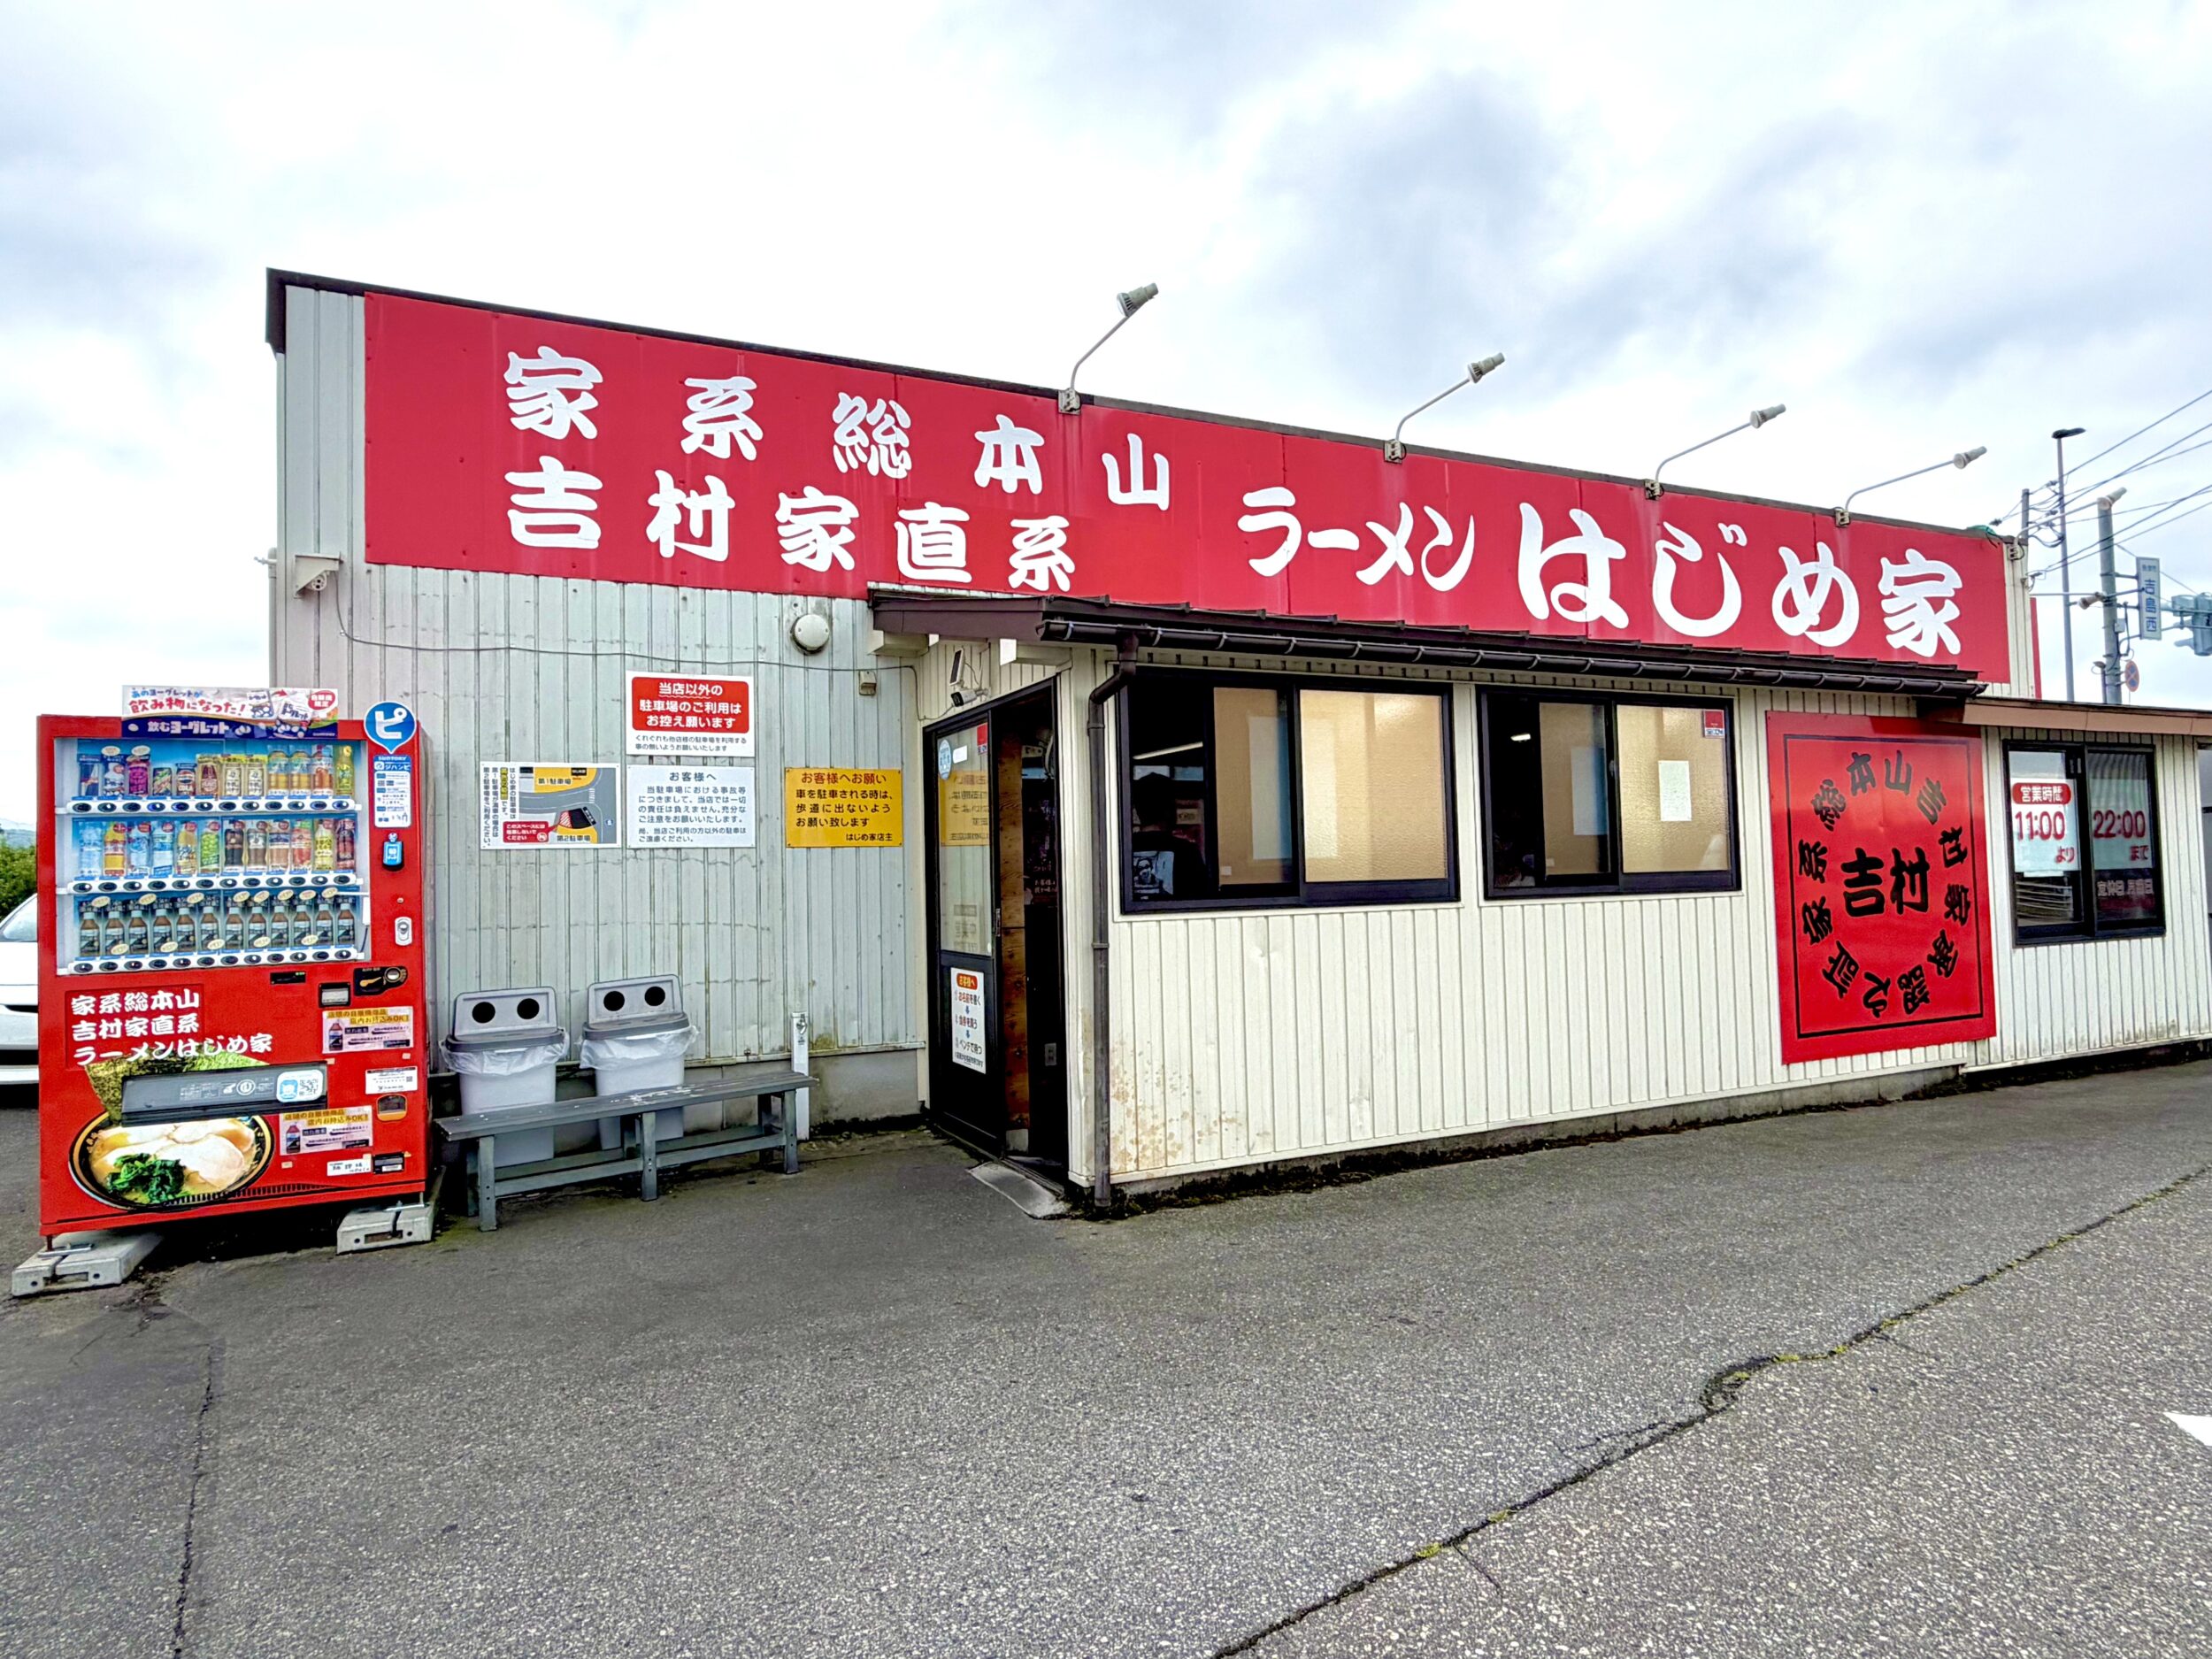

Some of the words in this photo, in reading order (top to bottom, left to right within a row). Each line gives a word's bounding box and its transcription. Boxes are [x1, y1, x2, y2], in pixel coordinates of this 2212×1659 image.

[503, 345, 1171, 511] 家系総本山
[503, 455, 1077, 592] 吉村家直系
[1237, 485, 1476, 592] ラーメン
[1518, 501, 1965, 657] はじめ家
[659, 681, 723, 696] 当店以外の
[639, 699, 742, 715] 駐車場のご利用は
[647, 715, 736, 729] お控え願います
[669, 772, 717, 782] お客様へ
[802, 772, 887, 785] お客様へお願い
[647, 786, 747, 795] 当駐車場における事故等
[796, 789, 893, 800] 車を駐車される時は、
[2020, 786, 2063, 803] 営業時間
[796, 803, 891, 813] 歩道に出ないよう
[796, 818, 870, 827] お願い致します
[2015, 810, 2065, 841] 11:00
[2093, 810, 2146, 839] 22:00
[2055, 846, 2075, 863] より
[2130, 845, 2149, 861] まで
[1840, 848, 1932, 917] 吉村
[71, 988, 200, 1016] 家系総本山
[71, 1013, 200, 1041] 吉村家直系
[73, 1033, 273, 1066] ラーメンはじめ家
